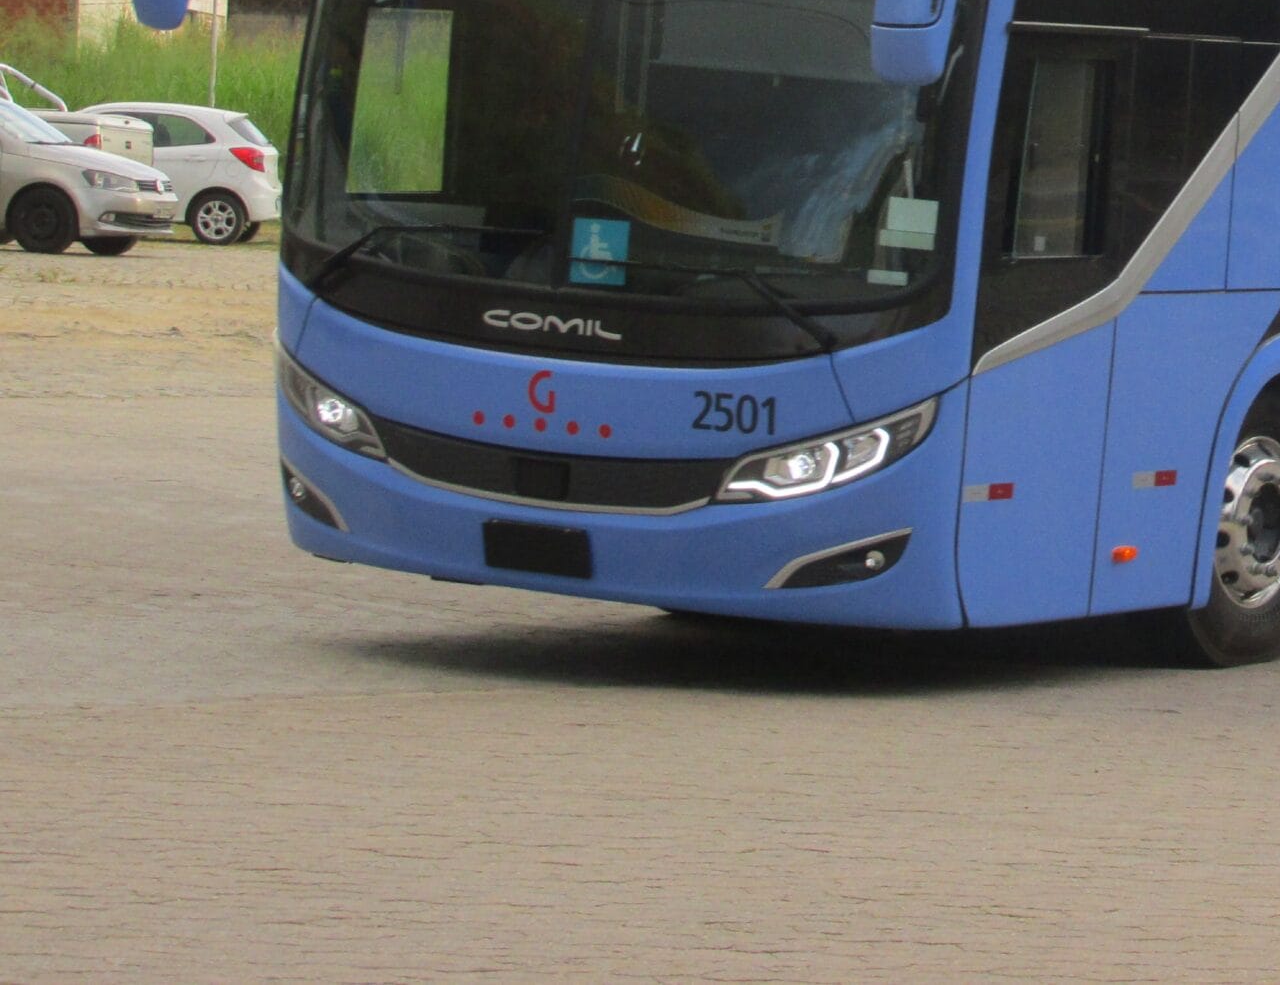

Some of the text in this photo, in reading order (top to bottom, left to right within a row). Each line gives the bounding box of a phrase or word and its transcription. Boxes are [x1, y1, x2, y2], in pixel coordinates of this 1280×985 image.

[482, 309, 622, 340] COMIL
[528, 370, 556, 414] G
[691, 390, 777, 435] 2501
